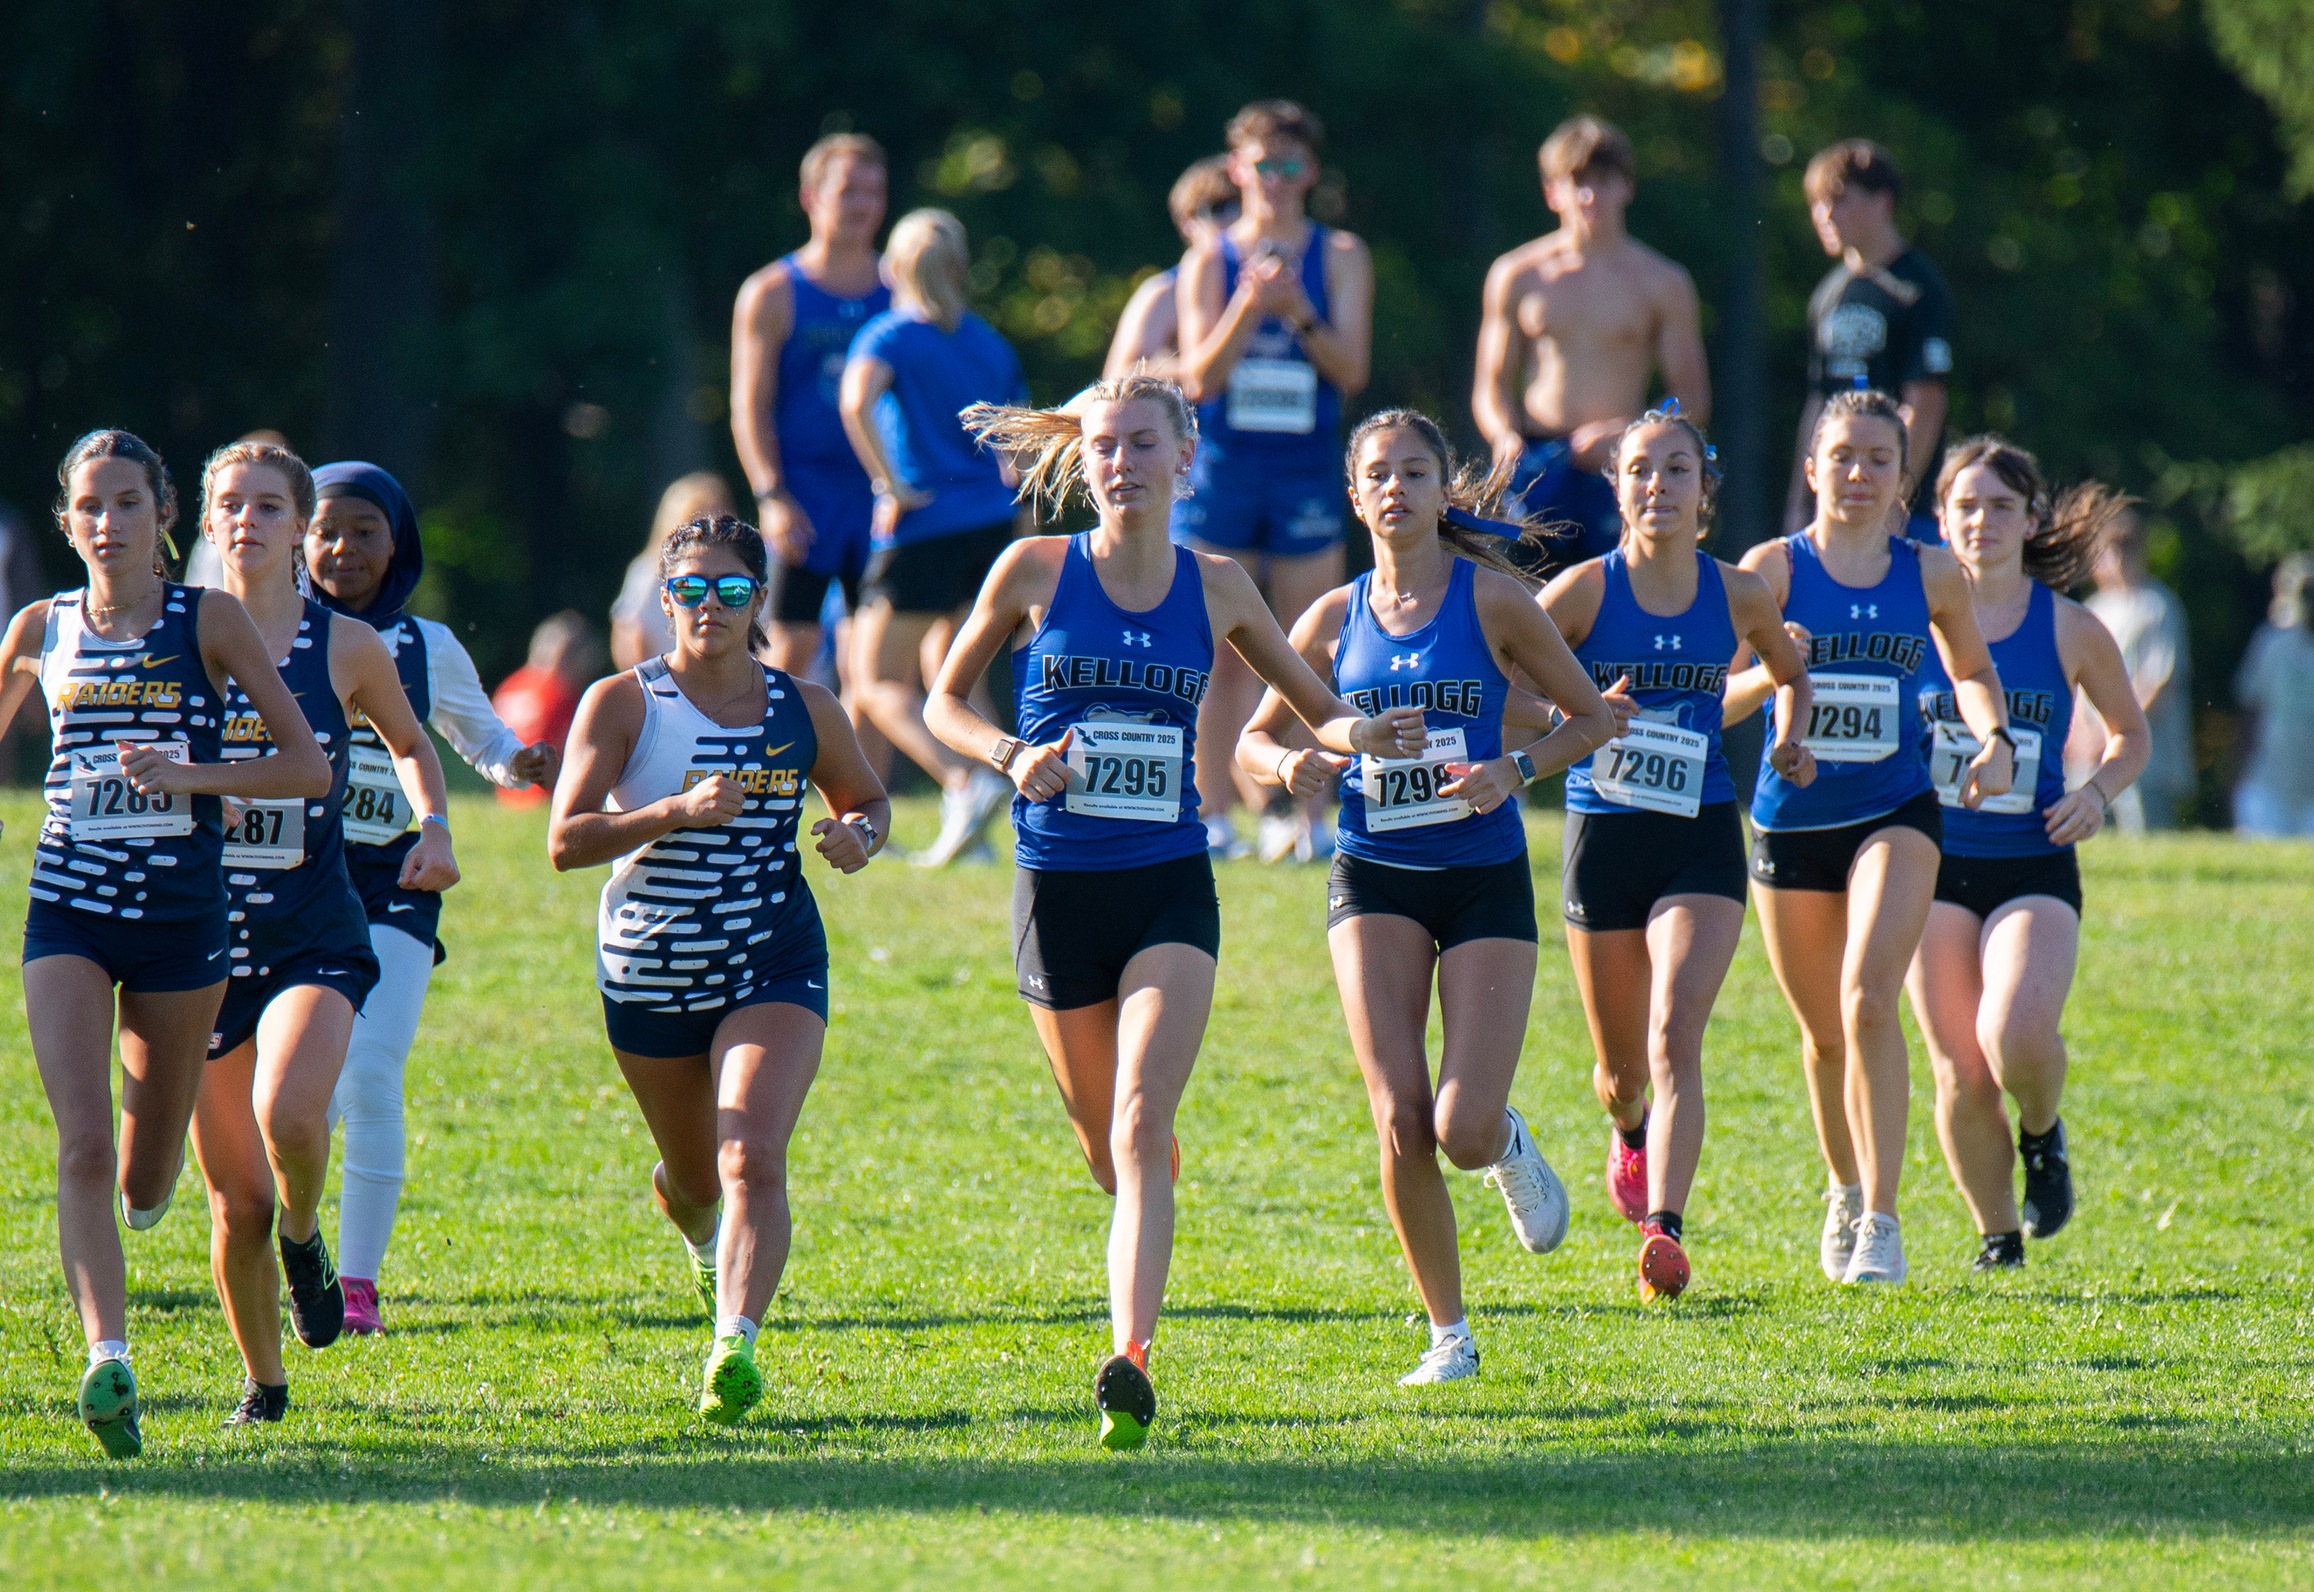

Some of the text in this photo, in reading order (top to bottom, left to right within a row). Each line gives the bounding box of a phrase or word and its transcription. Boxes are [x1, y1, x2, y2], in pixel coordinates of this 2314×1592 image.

[1807, 631, 1927, 675] ELLOGG
[56, 681, 182, 712] RAIDERS
[1340, 680, 1482, 718] ELLOGG
[1838, 682, 1870, 691] COUNTRY
[1093, 730, 1176, 744] CROSS COUNTRY 2025
[1435, 736, 1457, 748] 2025
[1630, 727, 1700, 748] OSS COUNTRY 2025
[93, 753, 117, 764] CROSS
[358, 762, 389, 775] COUNTRY
[1608, 747, 1688, 792] 7296
[682, 769, 799, 796] RDERS
[1084, 756, 1167, 797] 7295
[1373, 764, 1455, 808] 7298
[341, 784, 395, 824] 284
[224, 809, 284, 845] 287
